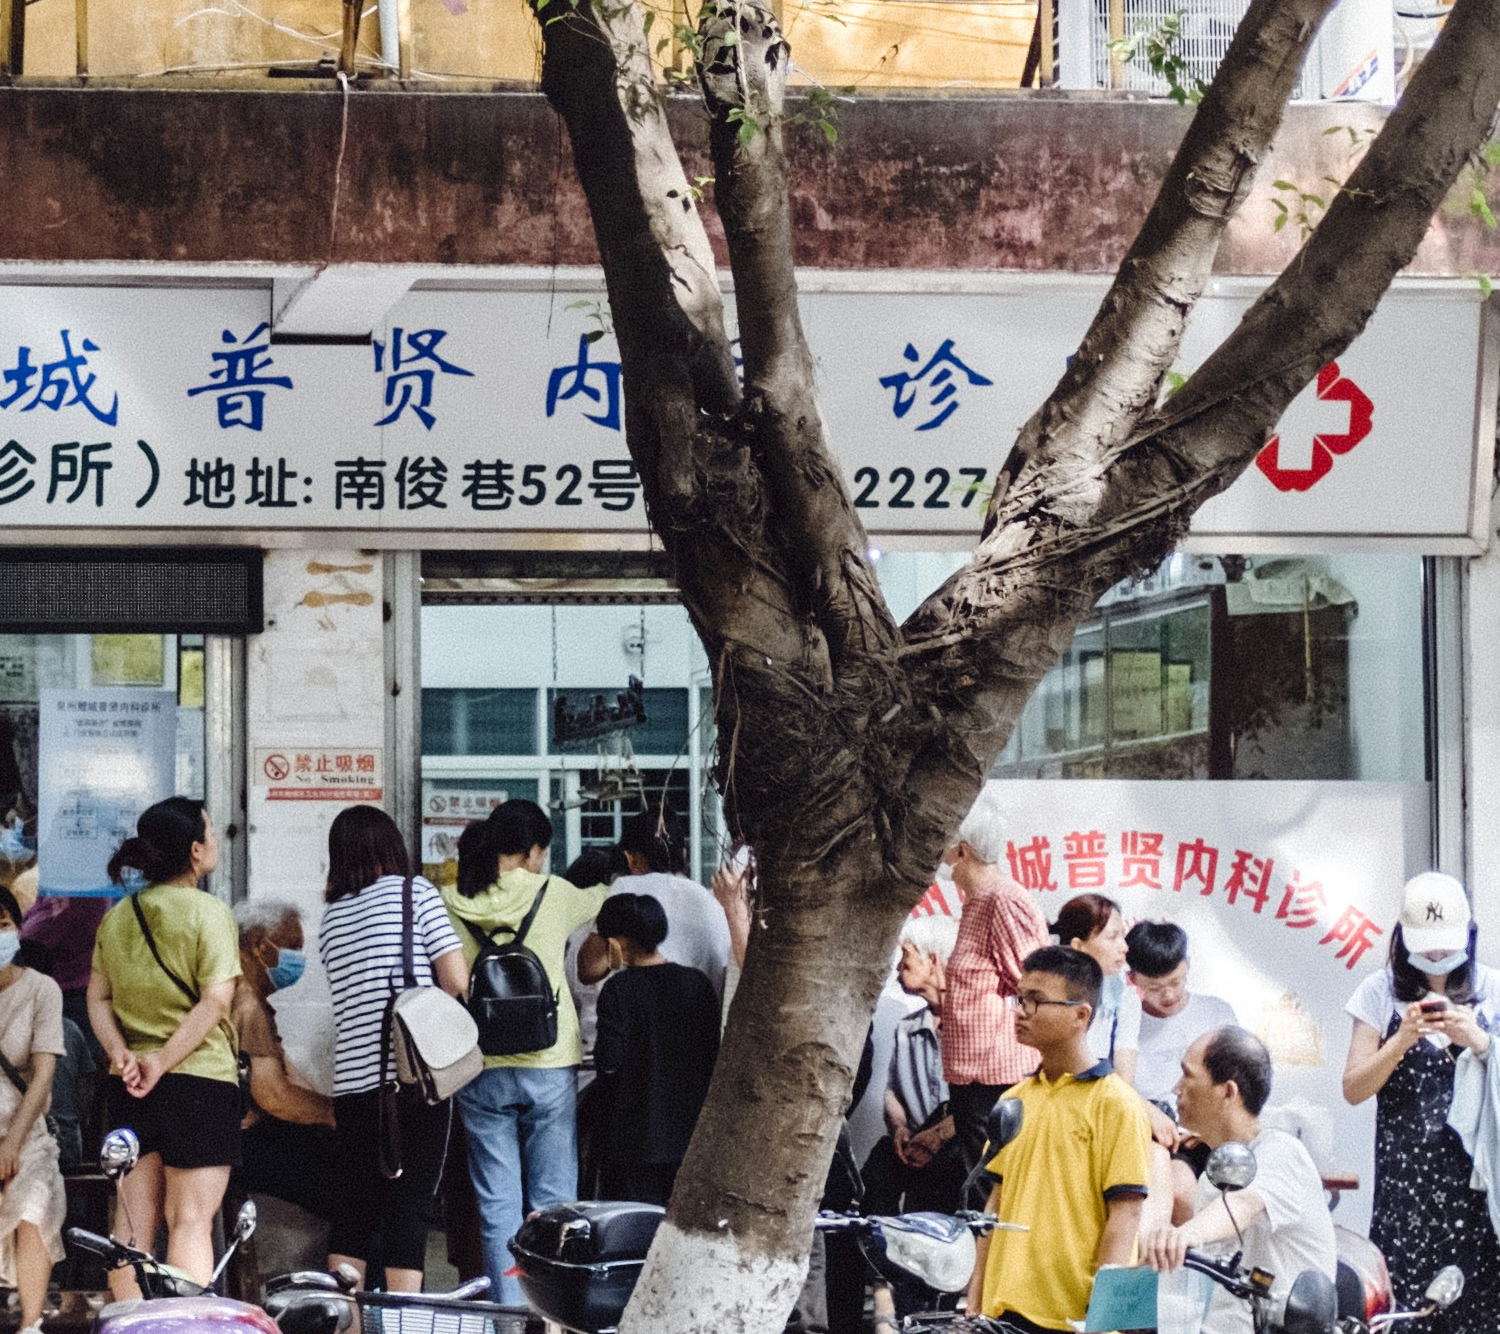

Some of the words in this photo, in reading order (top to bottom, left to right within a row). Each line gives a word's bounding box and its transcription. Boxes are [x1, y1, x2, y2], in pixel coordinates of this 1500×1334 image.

[295, 753, 375, 774] 禁止吸烟
[321, 774, 375, 785] Smoking
[911, 830, 1384, 972] 城普贤内科诊所
